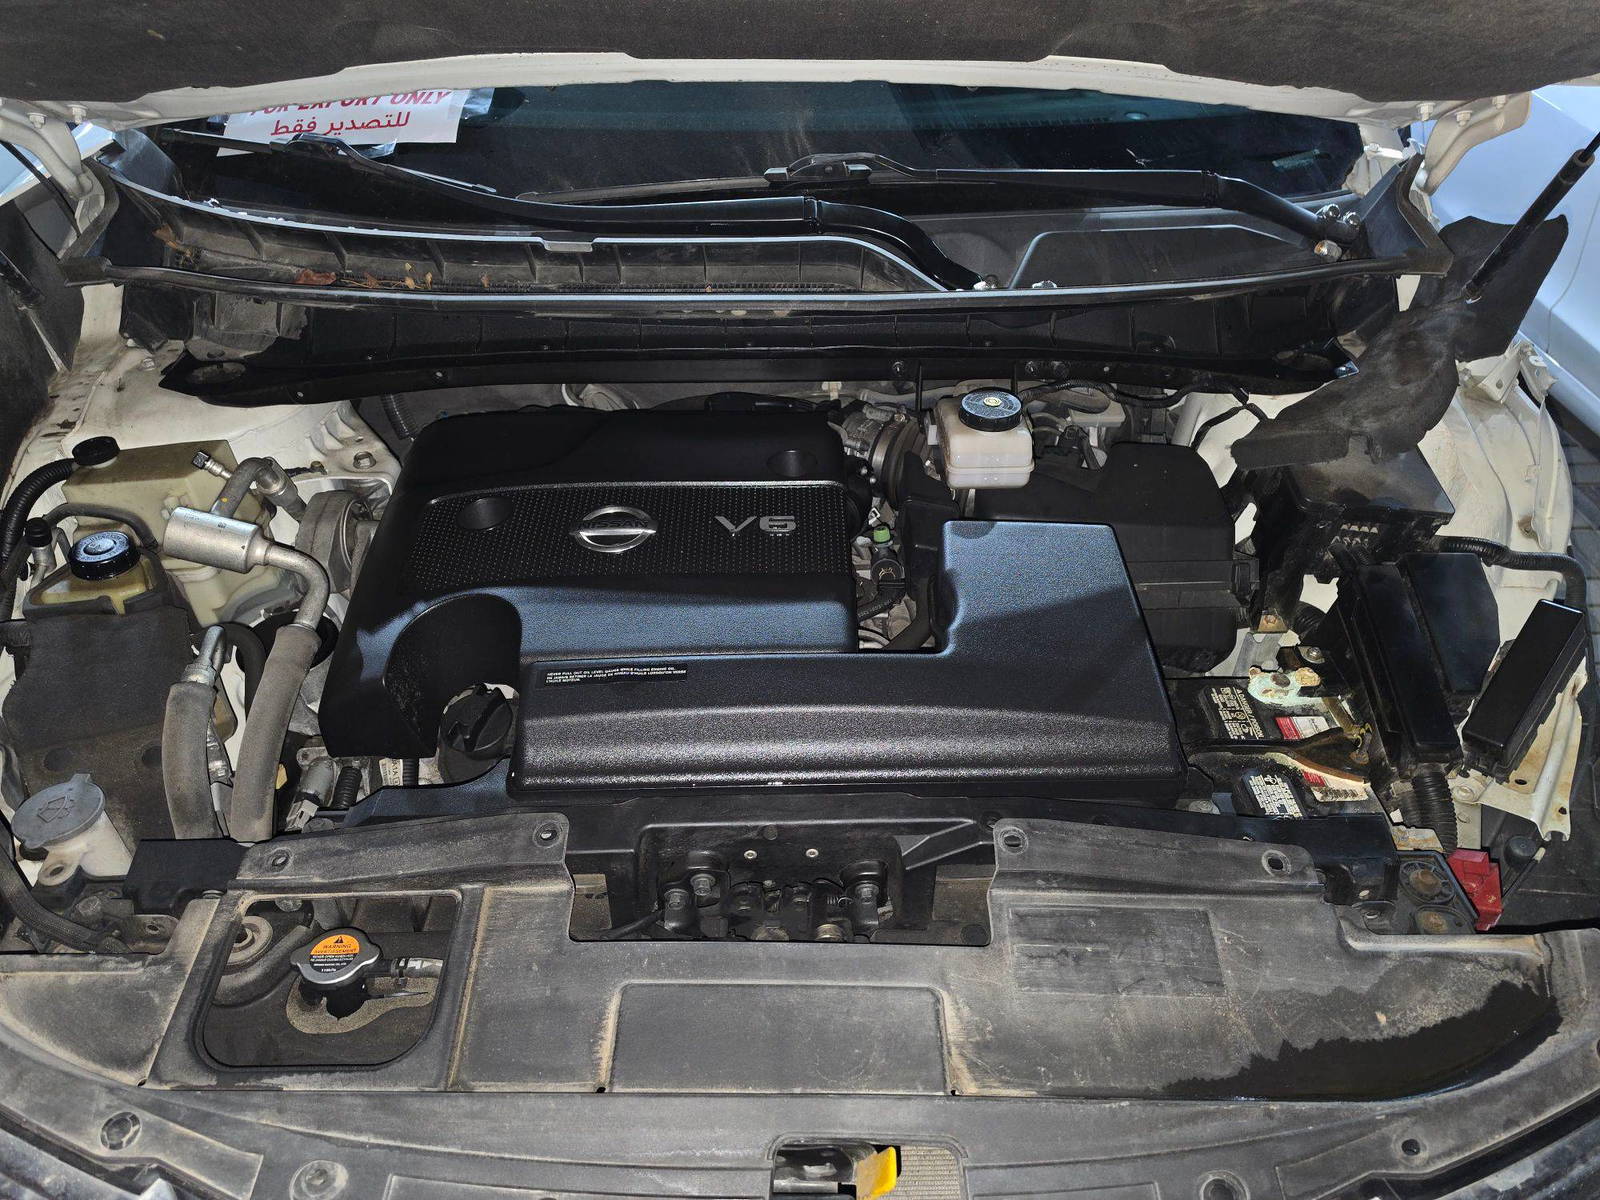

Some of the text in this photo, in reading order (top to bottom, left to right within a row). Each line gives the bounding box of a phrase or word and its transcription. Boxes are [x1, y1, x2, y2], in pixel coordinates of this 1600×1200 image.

[250, 105, 288, 115] OR
[390, 91, 452, 105] ONLY
[270, 111, 411, 136] للتصدير فقط
[714, 515, 797, 532] V6
